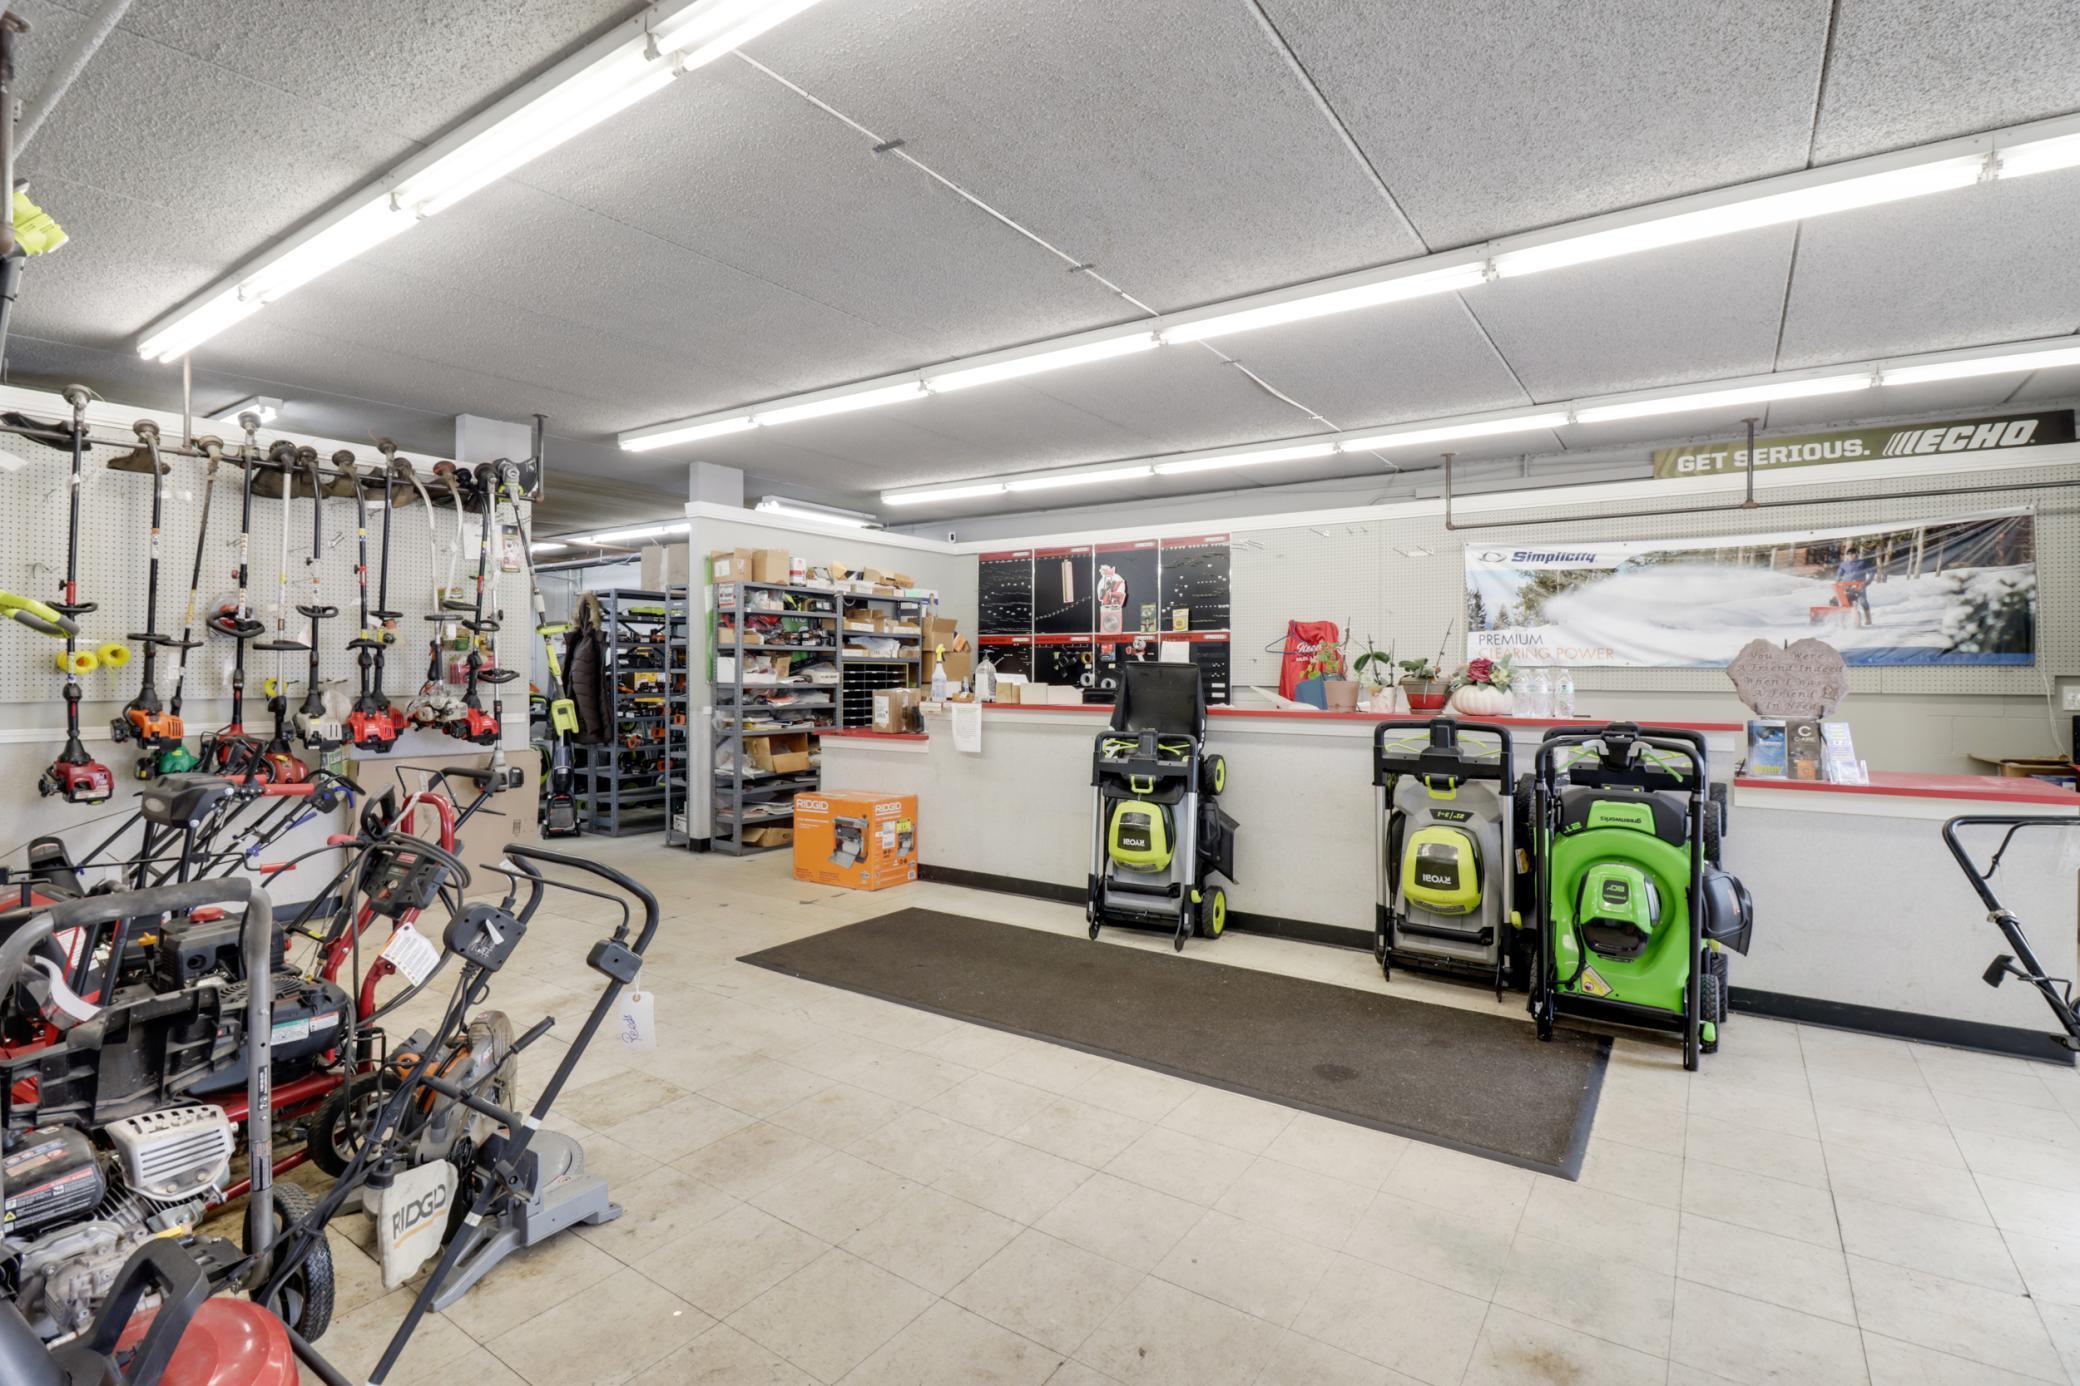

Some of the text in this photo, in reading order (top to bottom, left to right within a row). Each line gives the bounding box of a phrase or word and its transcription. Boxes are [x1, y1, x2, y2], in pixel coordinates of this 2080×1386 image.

[1913, 419, 2039, 455] ECHO
[1677, 438, 1870, 472] GET SERIOUS.
[1511, 551, 1597, 564] Simplicity
[1478, 634, 1543, 646] PREMIUM
[1556, 647, 1615, 660] POWER
[1751, 663, 1793, 673] Friend
[1768, 688, 1815, 699] Friend
[796, 799, 829, 810] RIDGID
[875, 802, 902, 814] RIDGID
[1122, 838, 1145, 847] RYOBI
[1422, 873, 1452, 885] RYOBI
[392, 1184, 447, 1240] RIDGID
